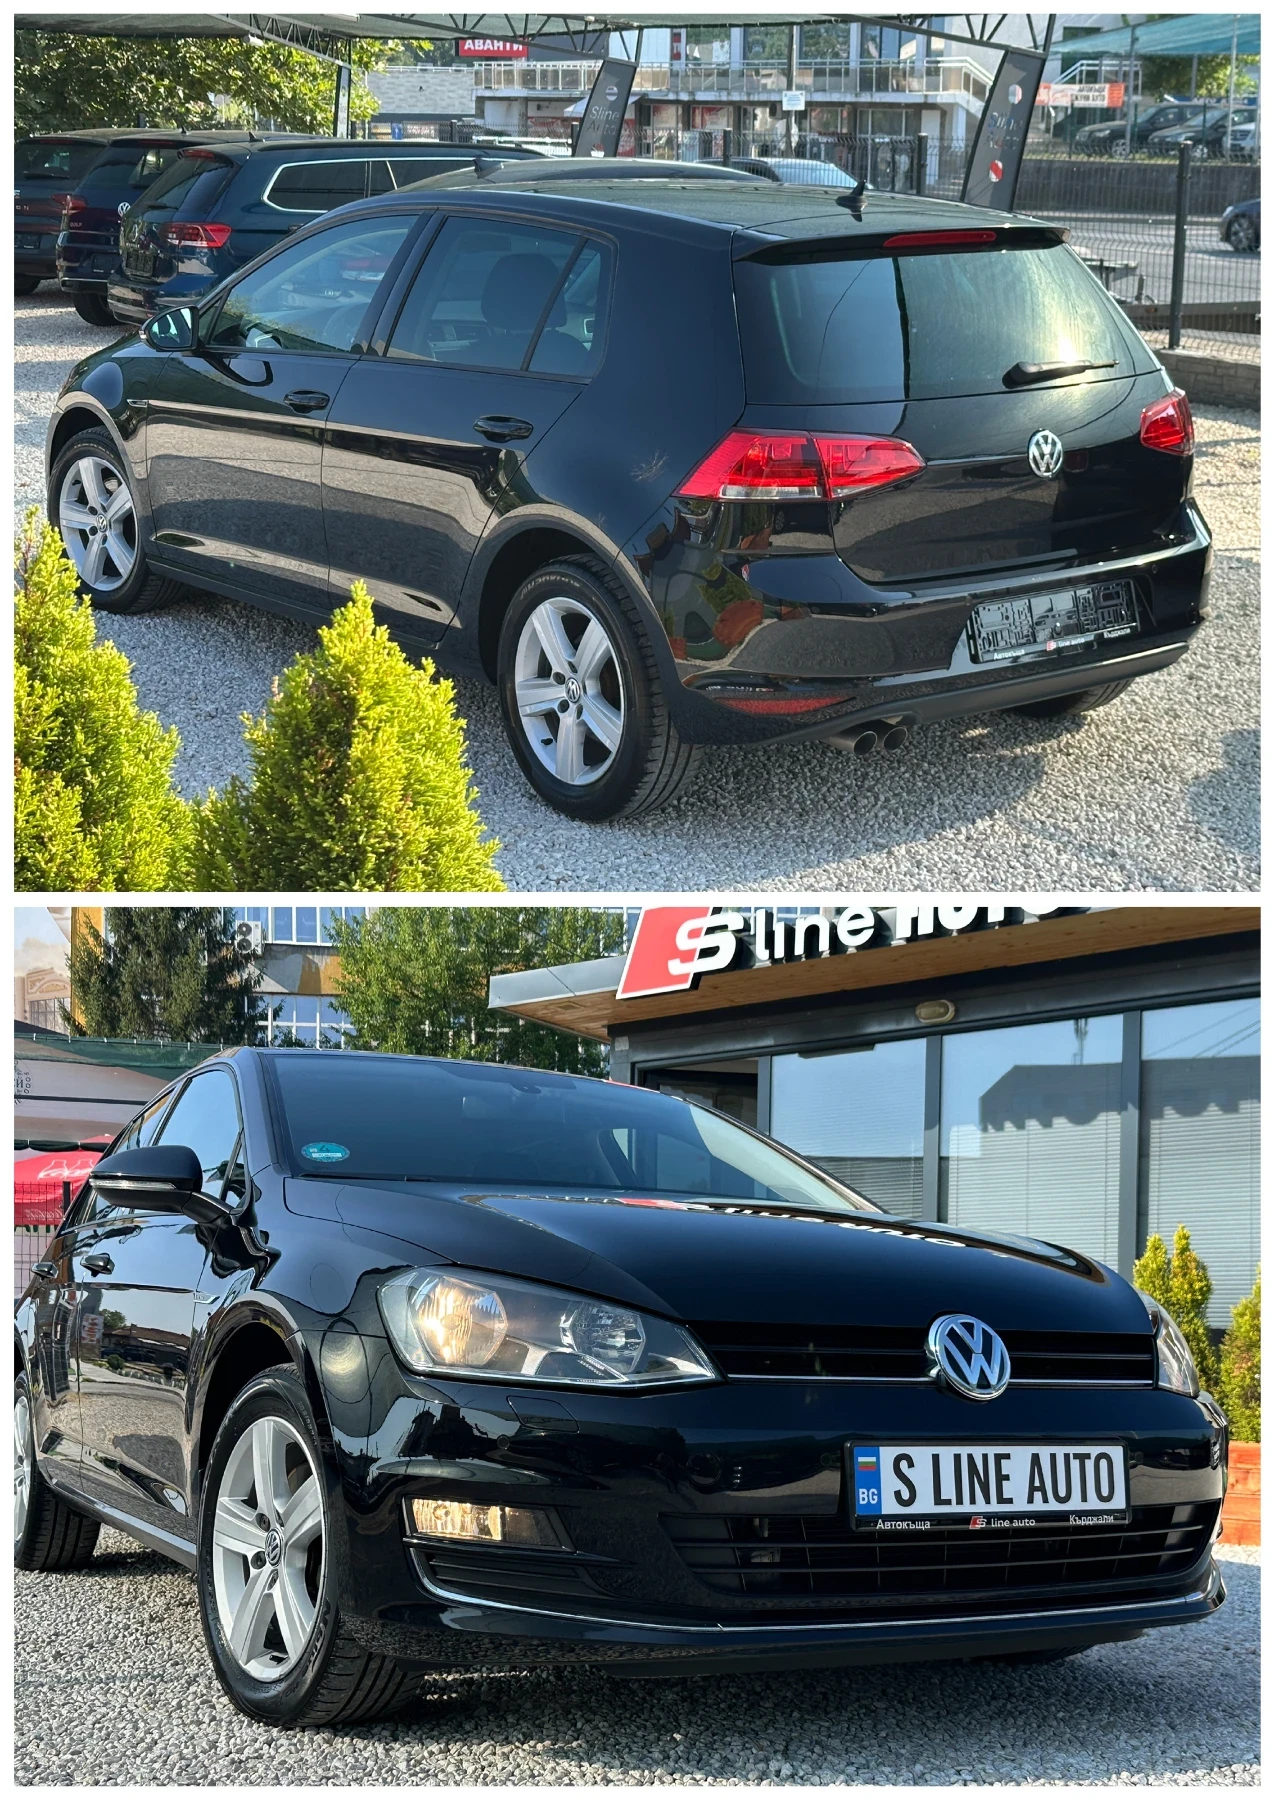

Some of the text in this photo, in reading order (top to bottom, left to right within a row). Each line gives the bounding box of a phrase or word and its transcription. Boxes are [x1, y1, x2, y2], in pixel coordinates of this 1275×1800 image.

[892, 1452, 1115, 1507] S LINE AUTO
[858, 1488, 878, 1505] BG
[876, 1518, 931, 1530] Автокъща
[991, 1518, 1010, 1528] line
[1012, 1518, 1036, 1527] auto
[1069, 1514, 1114, 1526] Кърджали
